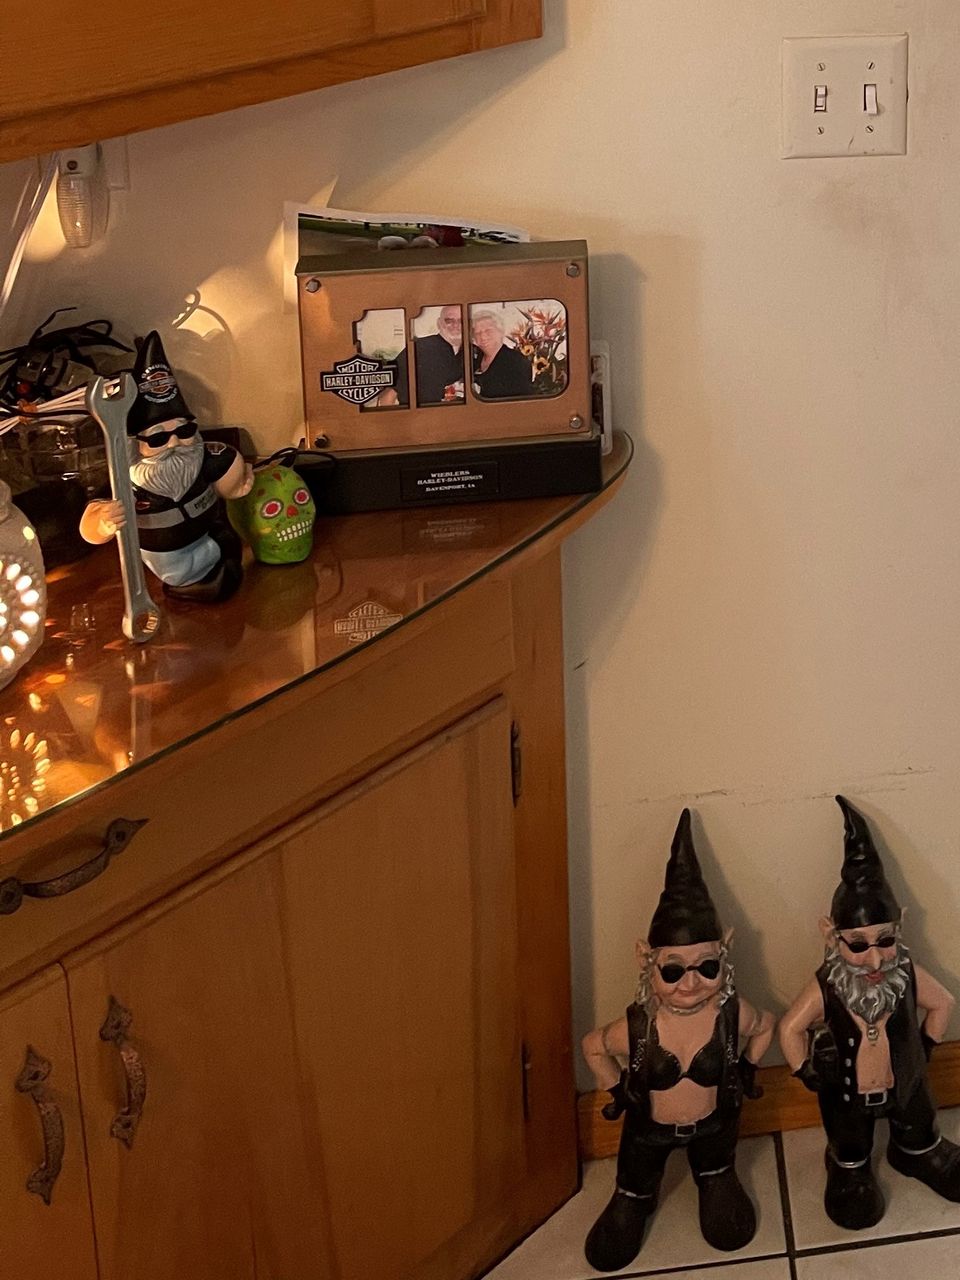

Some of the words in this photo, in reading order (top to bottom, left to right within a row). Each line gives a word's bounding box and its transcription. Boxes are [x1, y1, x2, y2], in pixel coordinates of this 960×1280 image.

[341, 361, 375, 373] MOTOR
[326, 373, 390, 387] HARLEY-DAVIDSON
[342, 386, 375, 400] CYCLES
